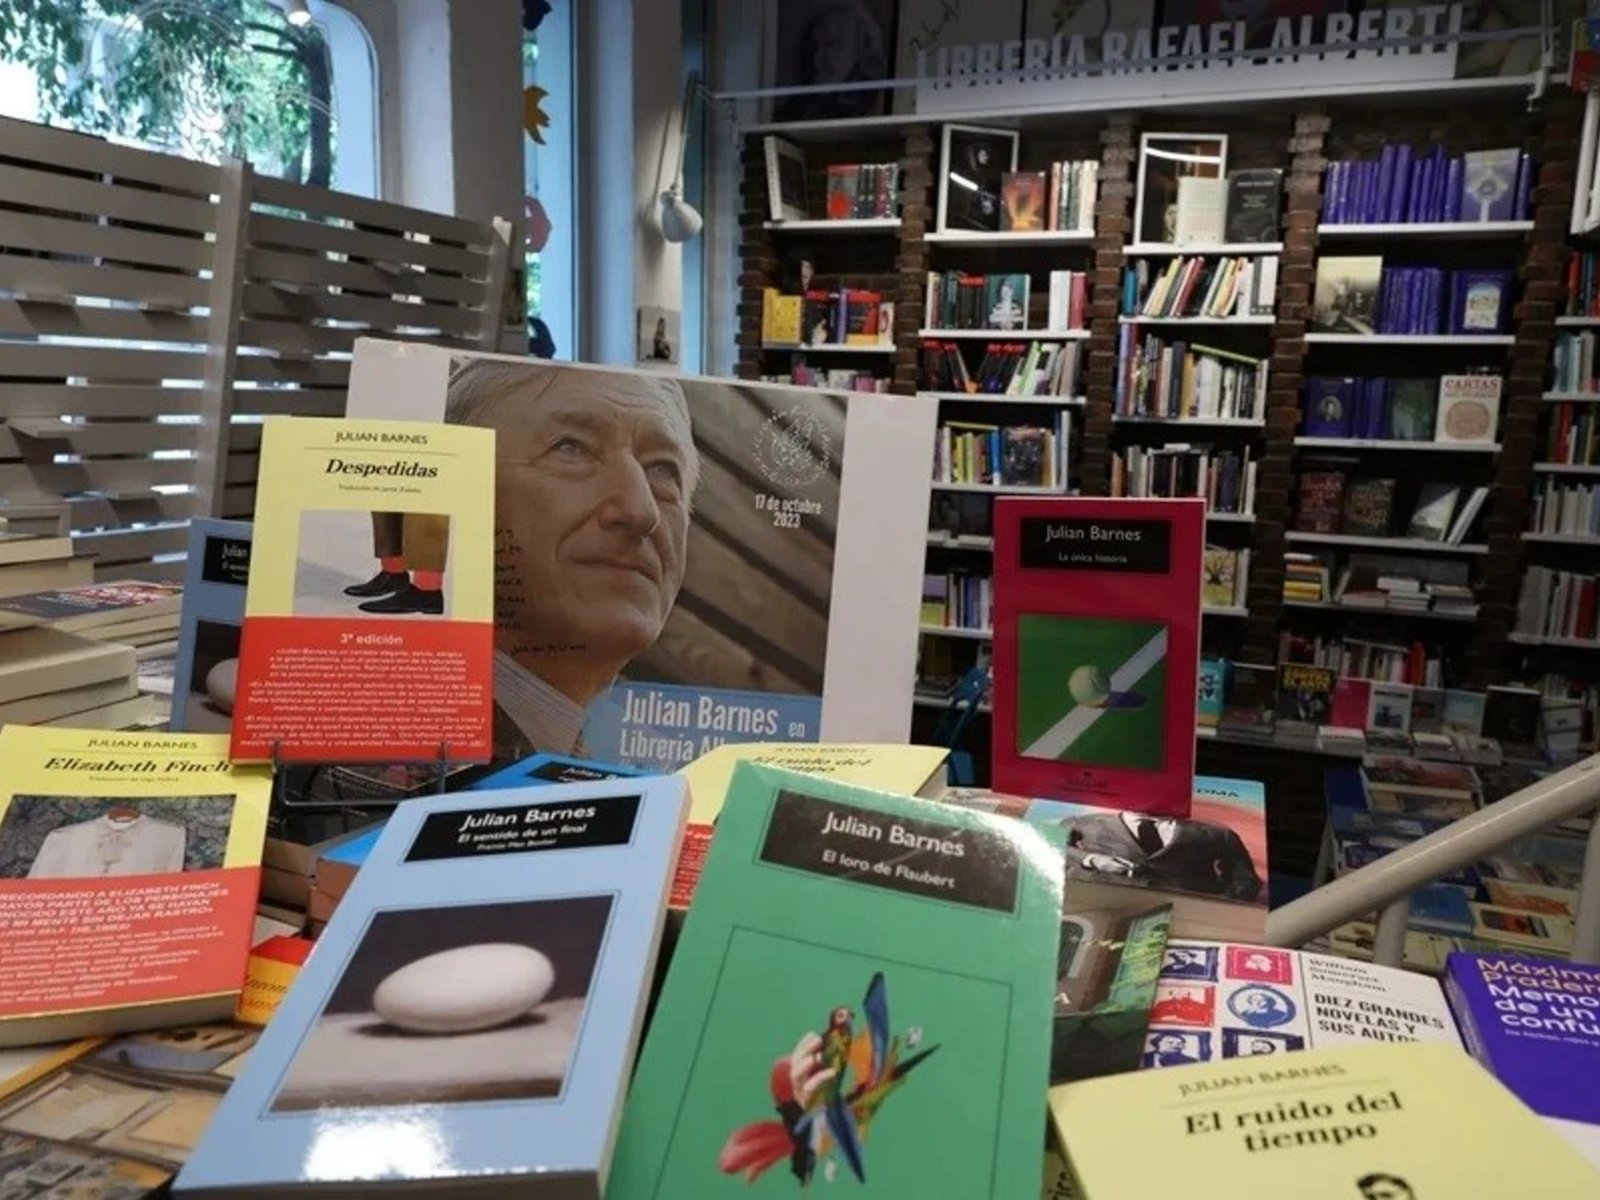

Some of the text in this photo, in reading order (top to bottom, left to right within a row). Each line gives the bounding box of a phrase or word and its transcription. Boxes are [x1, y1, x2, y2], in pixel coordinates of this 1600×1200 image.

[1103, 20, 1247, 74] RAFAEL
[1270, 4, 1463, 62] ALBERTI
[334, 431, 428, 445] JULIAN BARNES
[325, 459, 438, 478] Despedidas
[755, 494, 822, 514] 17 de octubre
[774, 512, 801, 528] 2023
[1045, 525, 1141, 542] Julian Barnes
[1059, 552, 1068, 561] La
[356, 633, 403, 645] edición
[622, 690, 805, 737] Julian Barnes en
[87, 740, 198, 749] JULIAN BARNES
[620, 729, 694, 761] Librería
[44, 757, 230, 772] Elizabeth Finch
[459, 806, 597, 832] Julian Barnes
[457, 823, 588, 844] El sentido de un final
[821, 811, 966, 857] Julian Barnes
[821, 850, 955, 889] El loro de Flaubert
[47, 899, 91, 909] PARTE
[94, 897, 112, 906] DE
[115, 895, 142, 905] LOS
[144, 888, 230, 902] PERSONAJES
[97, 890, 107, 898] A
[109, 885, 179, 898] ELIZABETH
[182, 881, 220, 892] FINCH
[59, 907, 94, 917] ESTE
[128, 903, 146, 912] YA
[148, 902, 166, 911] SE
[168, 897, 211, 909] HAYAN
[31, 916, 80, 927] MENTE
[82, 914, 105, 925] SIN
[107, 911, 152, 922] DEJAR
[1309, 959, 1369, 975] William
[1309, 966, 1379, 983] Somerset
[1311, 973, 1387, 992] Maugham
[1314, 992, 1445, 1030] DIEZ GRANDES
[1494, 998, 1597, 1021] de un
[1316, 1006, 1416, 1034] NOVELAS Y
[1319, 1019, 1356, 1036] SUS
[1178, 1062, 1346, 1097] JULIAN BARNES
[1185, 1090, 1404, 1135] El ruido del
[1244, 1124, 1379, 1154] tiempo
